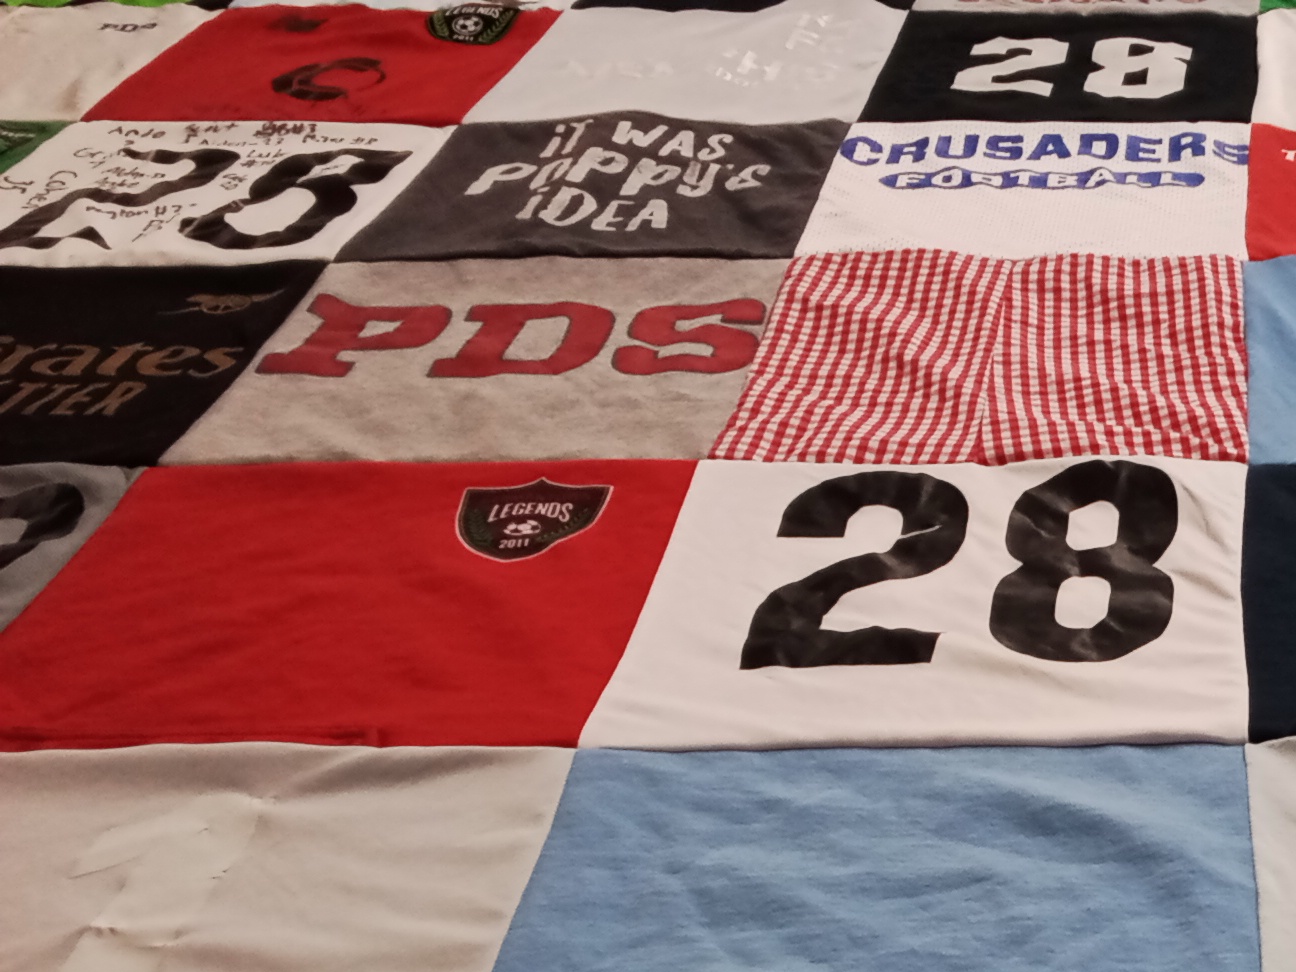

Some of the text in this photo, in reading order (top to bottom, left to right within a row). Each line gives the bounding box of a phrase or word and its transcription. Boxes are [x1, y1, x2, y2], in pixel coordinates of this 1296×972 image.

[950, 36, 1193, 99] 28
[611, 121, 734, 161] WAS
[840, 132, 1250, 166] CRUSADERS
[895, 168, 1190, 188] FOOTBALL
[255, 293, 766, 379] PDS
[487, 501, 574, 523] LEGENDS
[498, 537, 530, 550] 2011
[739, 459, 1179, 671] 28
